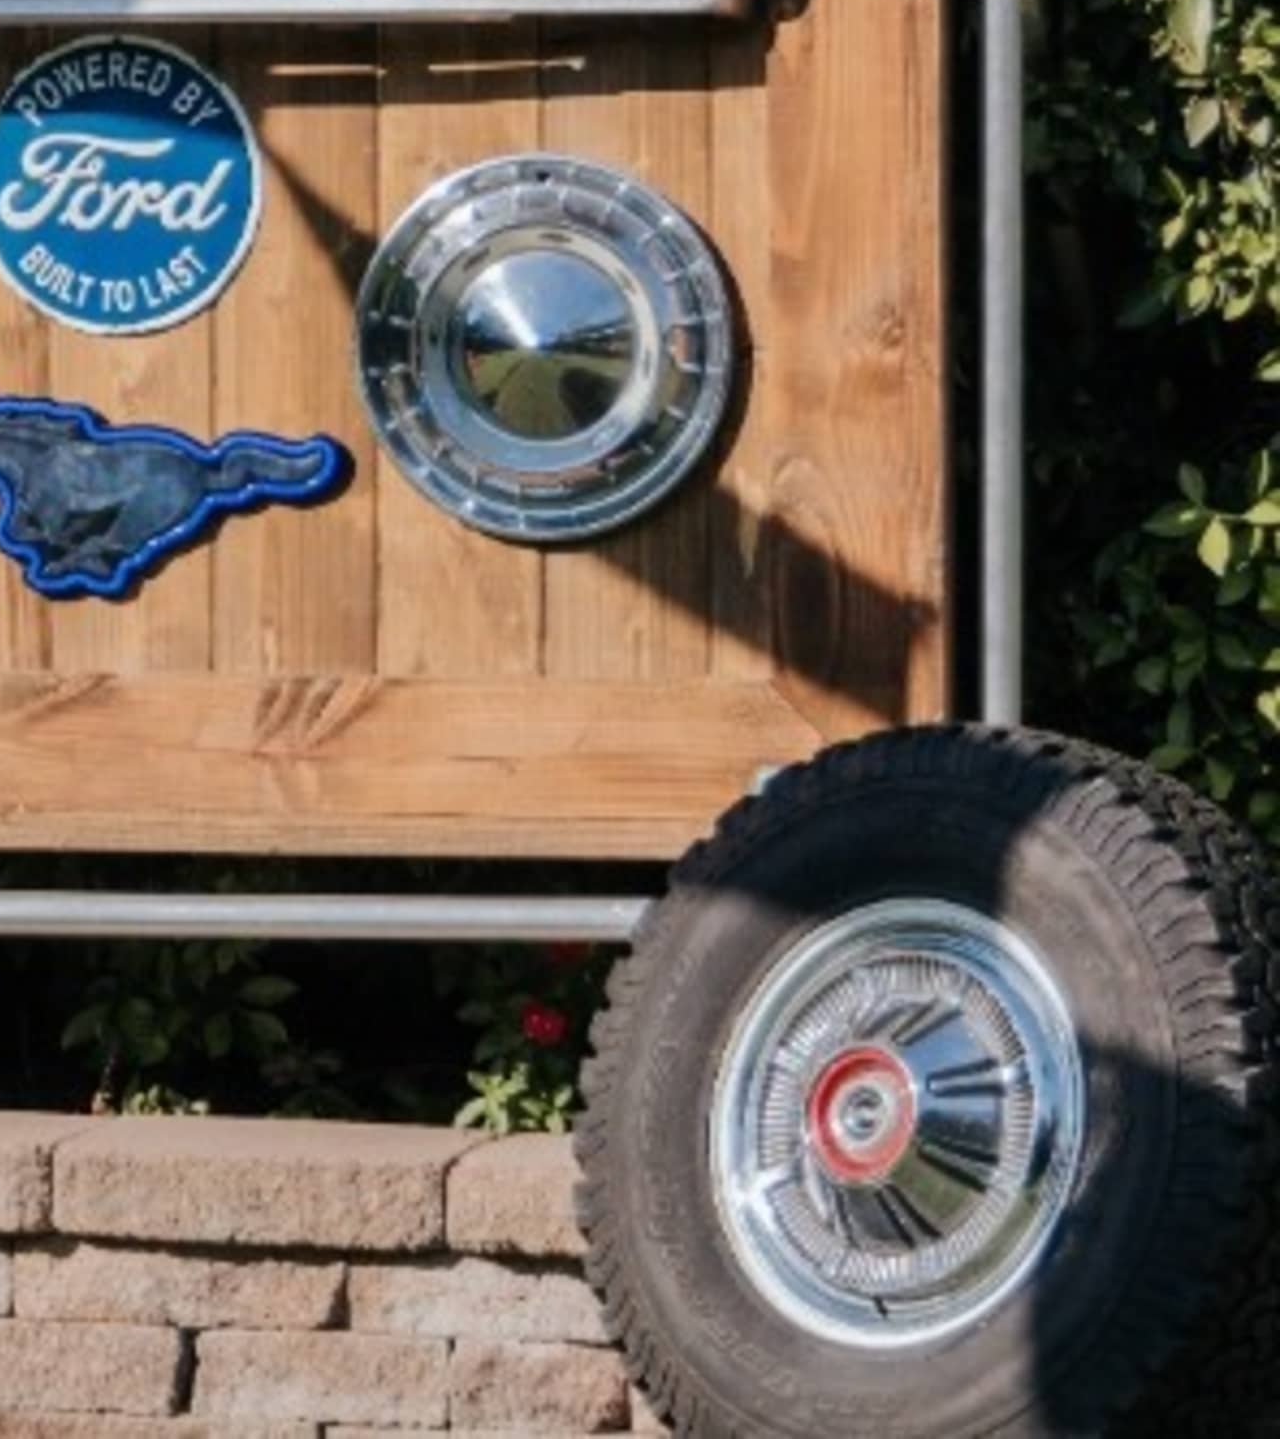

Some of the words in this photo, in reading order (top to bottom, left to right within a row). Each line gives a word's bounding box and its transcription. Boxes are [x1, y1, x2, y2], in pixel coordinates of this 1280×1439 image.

[14, 51, 172, 128] POWERED
[171, 80, 223, 127] BY
[18, 243, 94, 308] BUILT
[100, 278, 136, 312] TO
[139, 245, 207, 308] LAST
